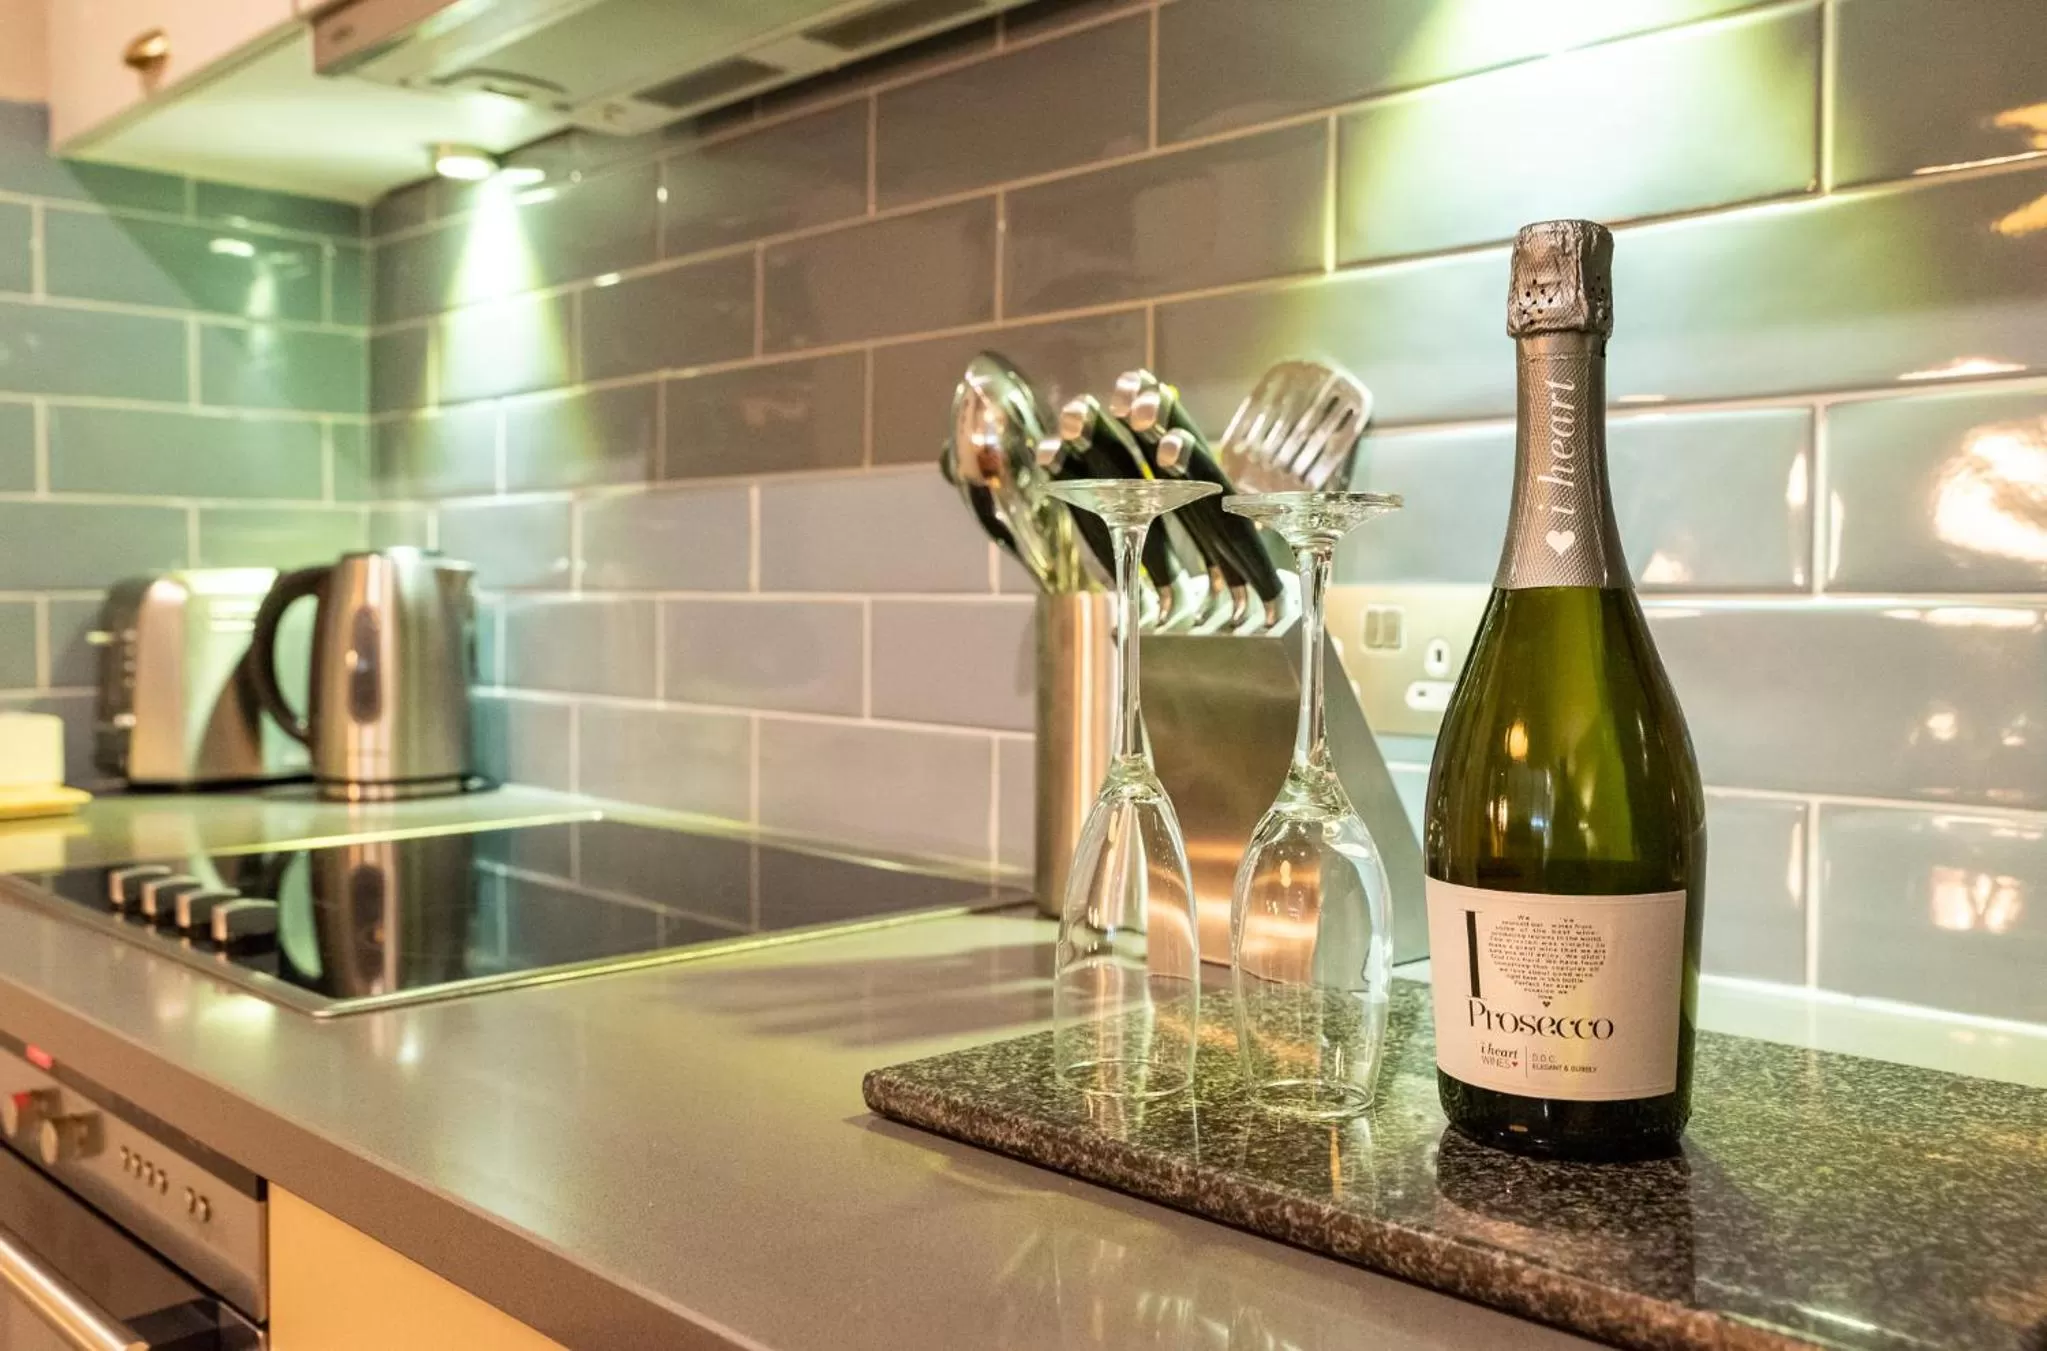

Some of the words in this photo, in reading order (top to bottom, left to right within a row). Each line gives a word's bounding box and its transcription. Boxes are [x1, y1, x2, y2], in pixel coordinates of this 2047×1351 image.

[1537, 379, 1576, 488] heart
[1537, 504, 1575, 515] i
[1459, 908, 1487, 1001] I
[1468, 998, 1614, 1040] Prosecco
[1481, 1056, 1510, 1068] WINES
[1487, 1043, 1518, 1059] heart
